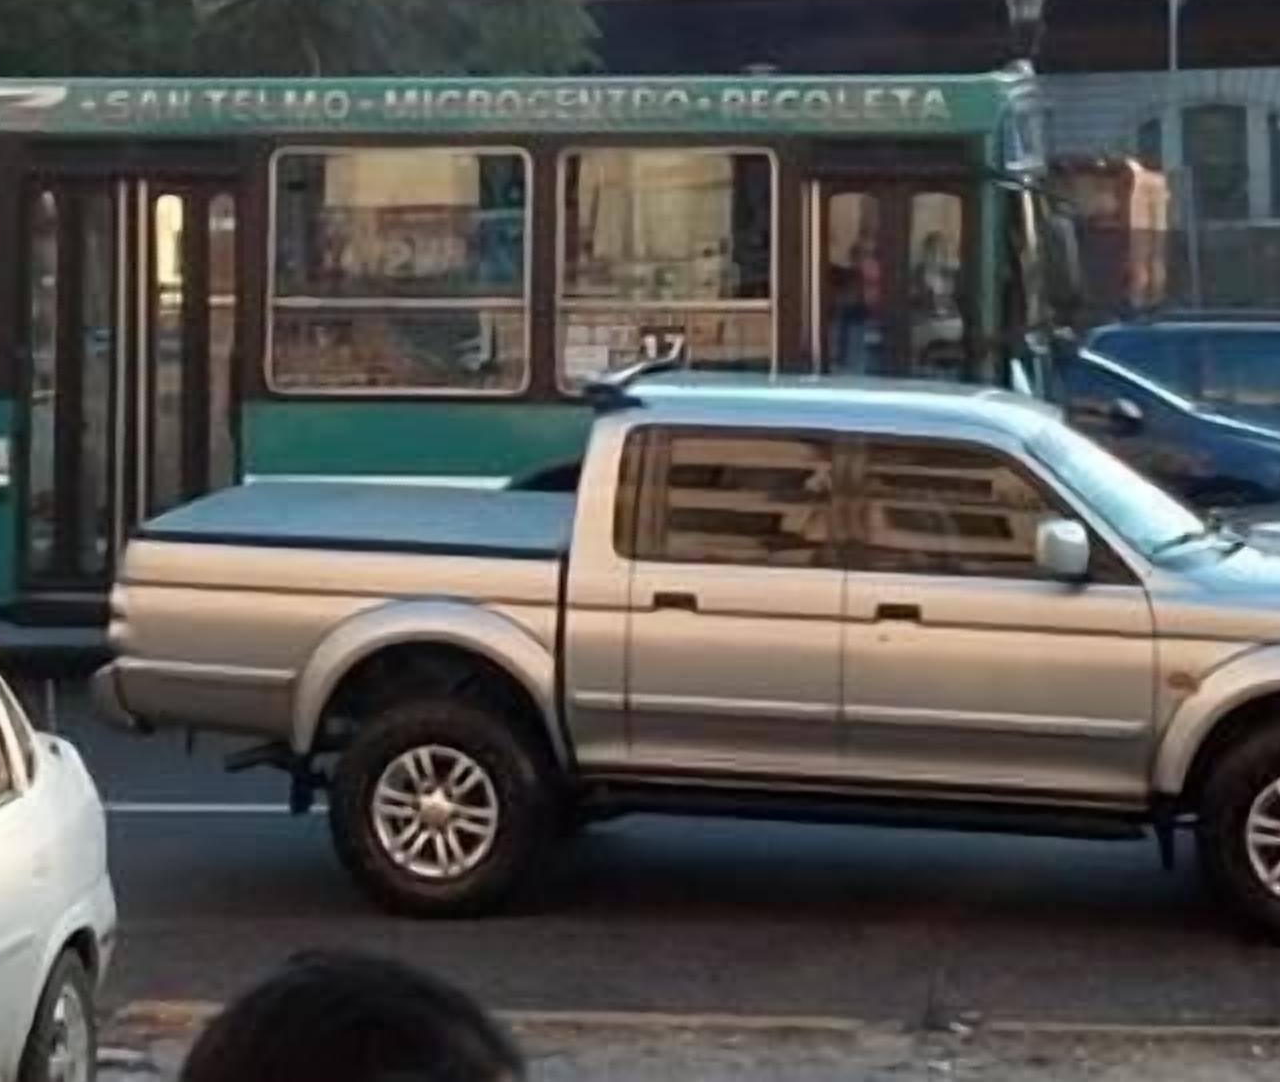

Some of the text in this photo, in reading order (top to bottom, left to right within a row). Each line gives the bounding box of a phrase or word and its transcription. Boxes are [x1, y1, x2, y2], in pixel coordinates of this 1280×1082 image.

[104, 89, 191, 121] SAN
[204, 89, 349, 121] TELMO
[643, 333, 685, 360] 17
